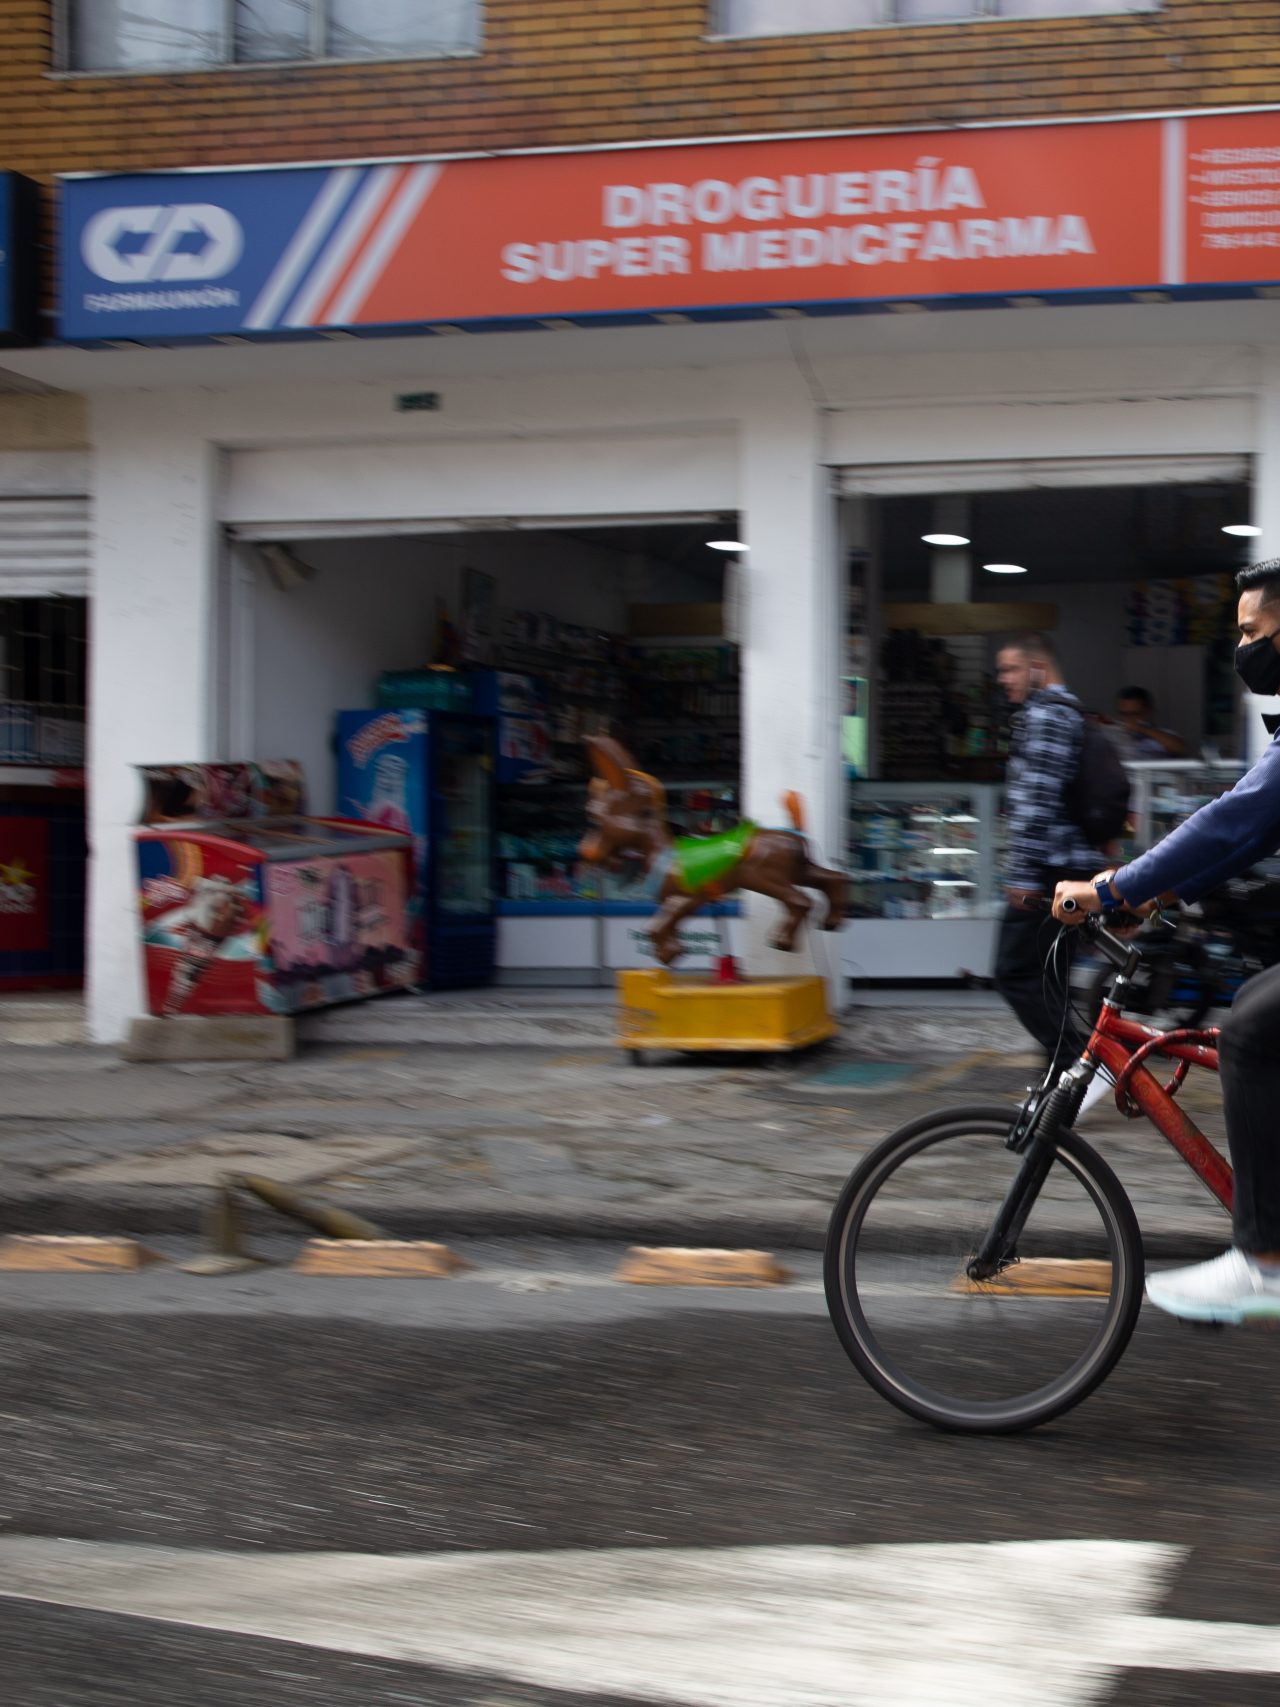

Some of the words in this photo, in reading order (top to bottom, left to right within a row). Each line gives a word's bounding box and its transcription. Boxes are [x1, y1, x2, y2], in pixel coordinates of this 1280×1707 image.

[603, 157, 985, 227] DROGUERÍA
[501, 236, 691, 283] SUPER
[703, 215, 1095, 272] MEDICFARMA
